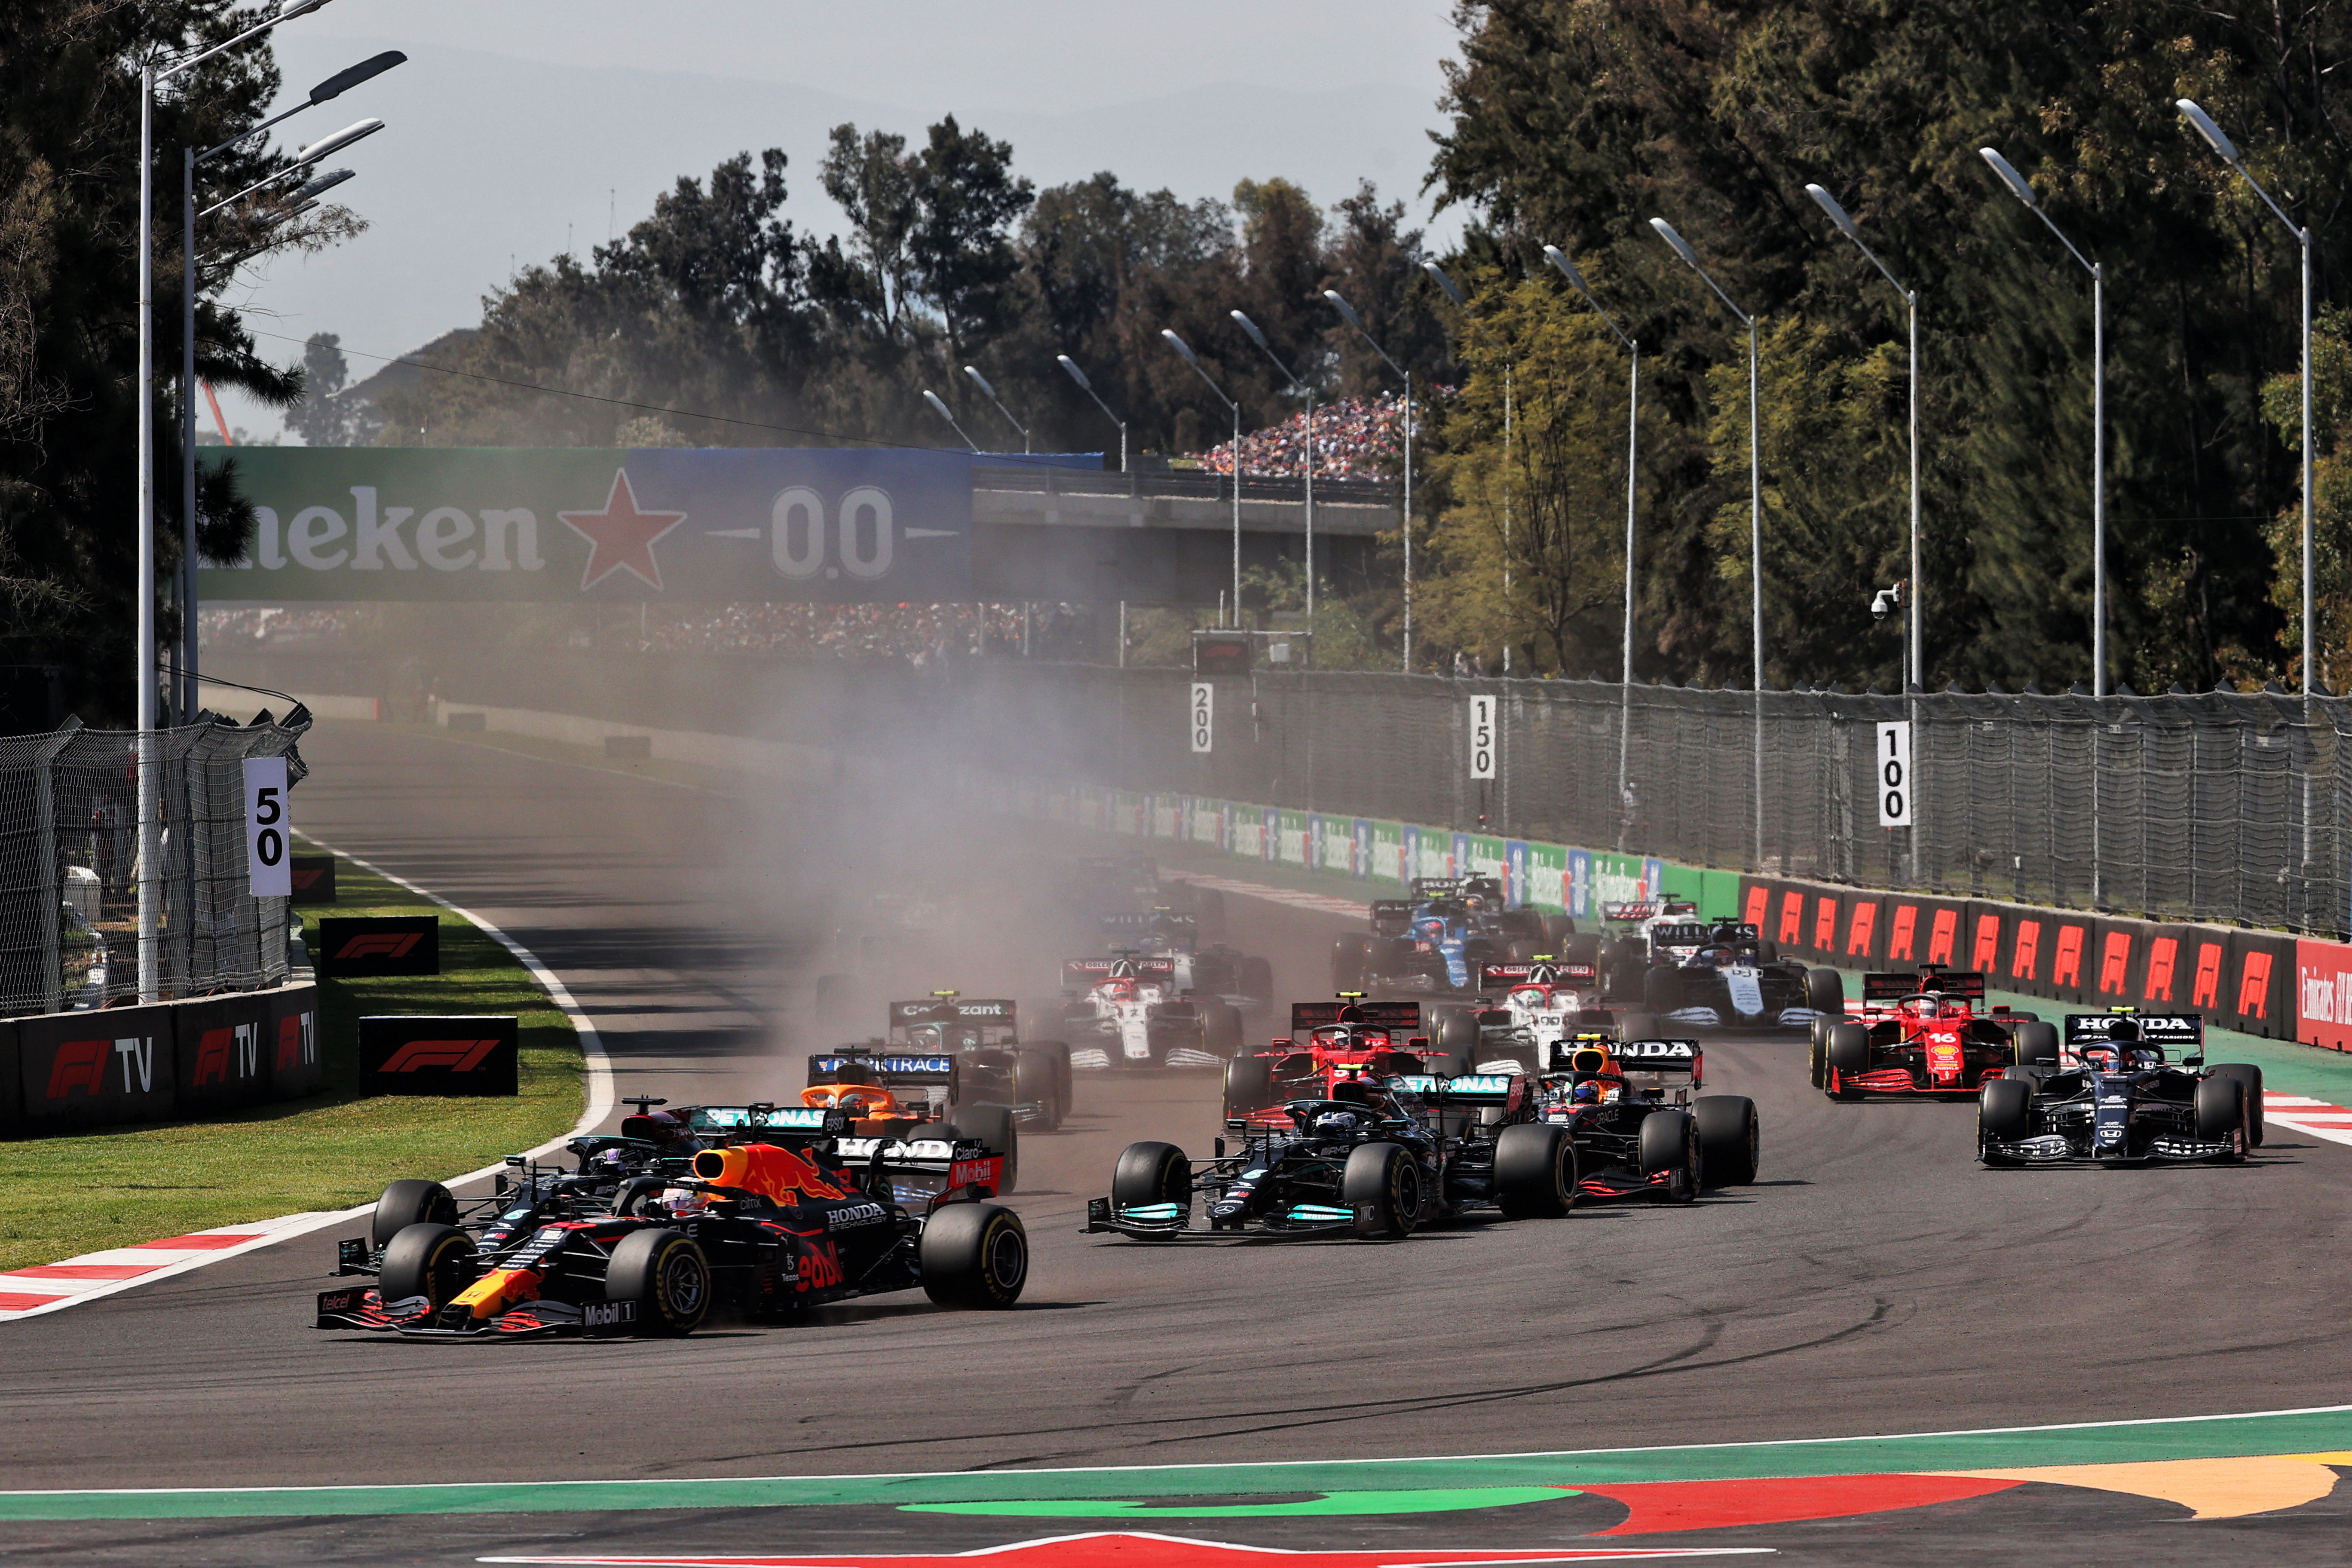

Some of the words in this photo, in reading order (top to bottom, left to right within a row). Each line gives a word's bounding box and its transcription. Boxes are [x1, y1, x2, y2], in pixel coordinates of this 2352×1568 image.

[771, 484, 895, 580] 0.0
[1196, 688, 1208, 747] 200
[1476, 701, 1490, 773] 150
[1885, 730, 1903, 818] 100
[257, 787, 282, 867] 50
[2302, 966, 2334, 1022] Emirates
[2078, 1018, 2191, 1029] HODA
[300, 1011, 314, 1064] TV
[1929, 1033, 1957, 1043] 16
[235, 1022, 257, 1078] TV
[1559, 1042, 1693, 1056] HNDA
[115, 1037, 152, 1093] TV
[1510, 1082, 1525, 1096] EPSO
[707, 1108, 826, 1126] PETONAS
[1596, 1109, 1620, 1125] ORACLE
[1329, 1145, 1349, 1155] AMG
[955, 1161, 991, 1184] Mobil
[826, 1203, 887, 1224] HONDA
[1360, 1205, 1375, 1222] IWC
[781, 1273, 799, 1282] Tezos
[322, 1294, 350, 1311] telcel
[585, 1302, 619, 1326] Mobil
[625, 1303, 631, 1320] 1
